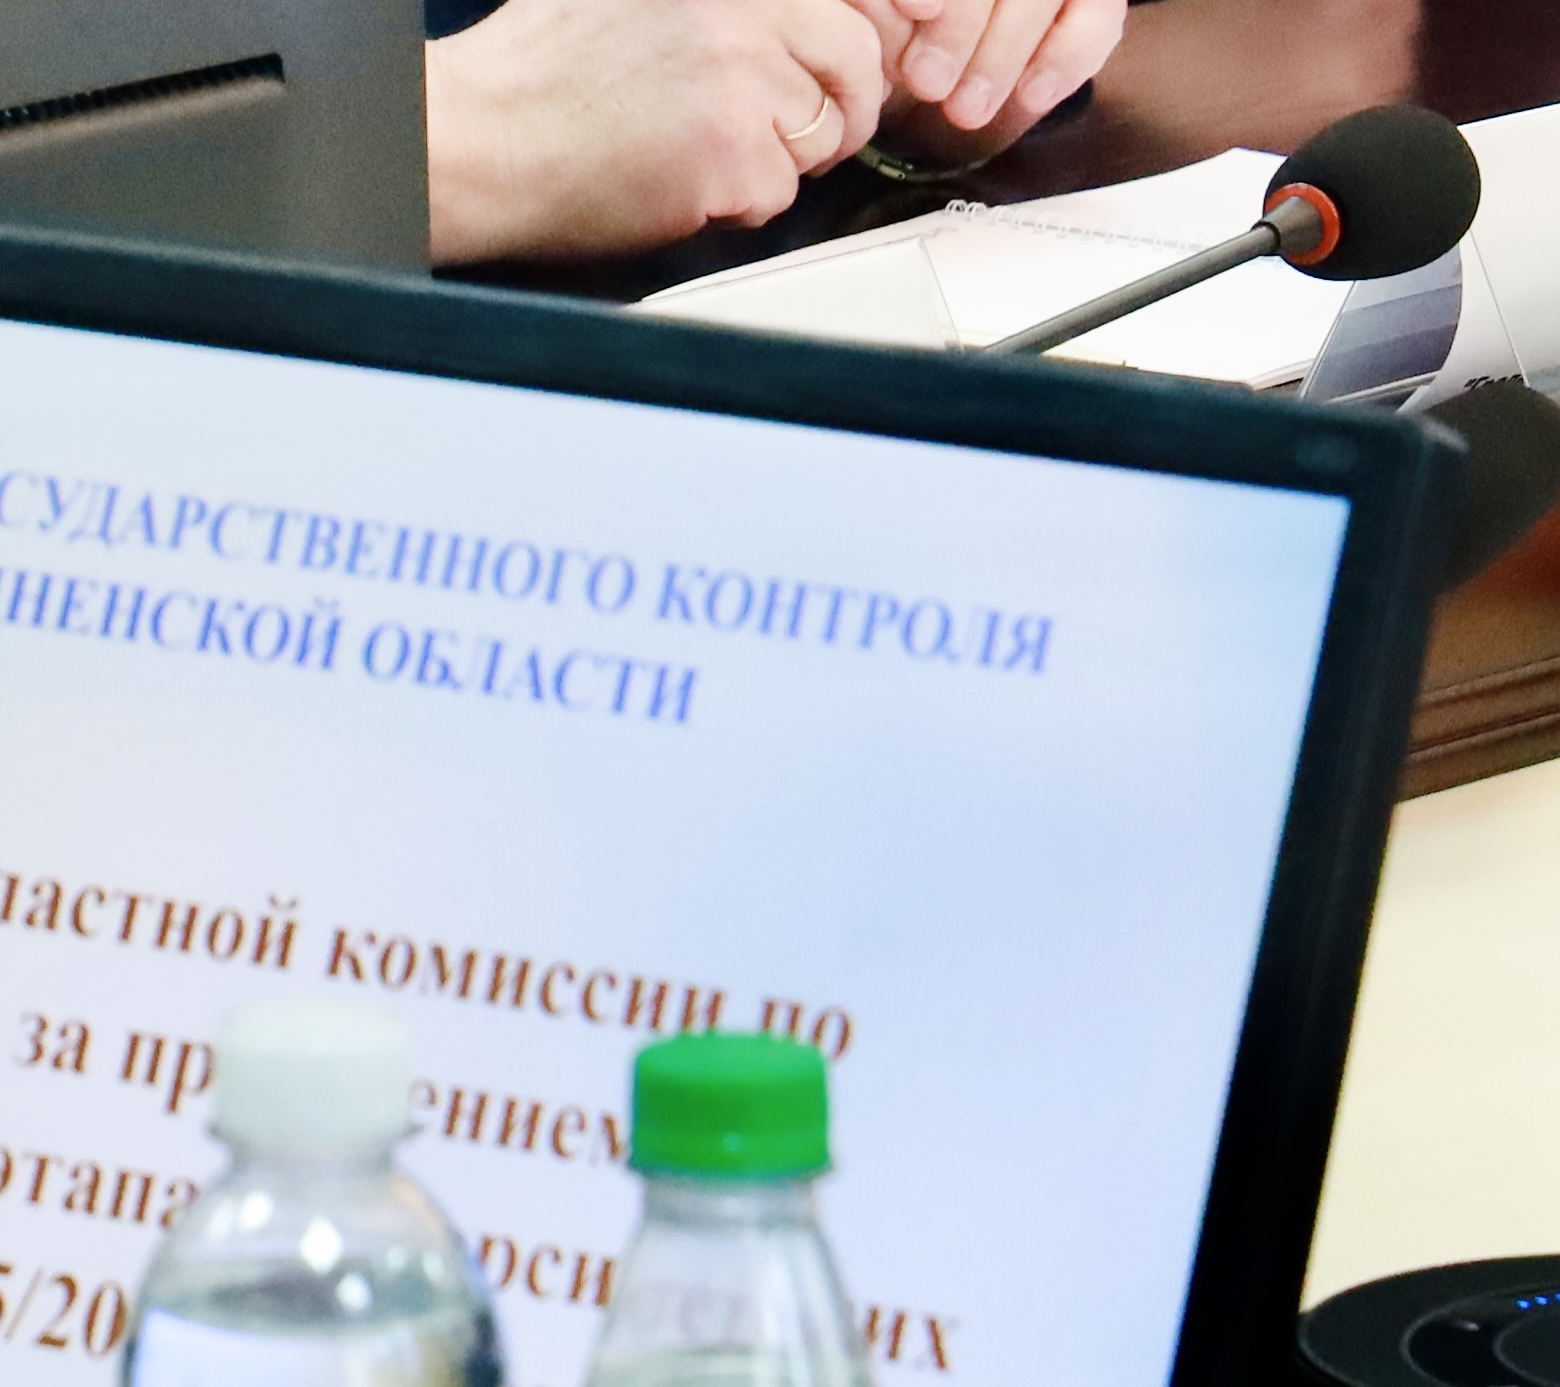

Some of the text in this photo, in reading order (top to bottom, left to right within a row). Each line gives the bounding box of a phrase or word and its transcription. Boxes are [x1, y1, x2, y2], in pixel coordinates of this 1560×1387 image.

[360, 617, 702, 727] ОБЛАСТИ
[655, 563, 1056, 676] КОНТРОЛЯ
[326, 927, 728, 1036] комиссии
[757, 997, 857, 1063] по
[14, 1010, 94, 1077] за
[118, 1027, 630, 1167] прением
